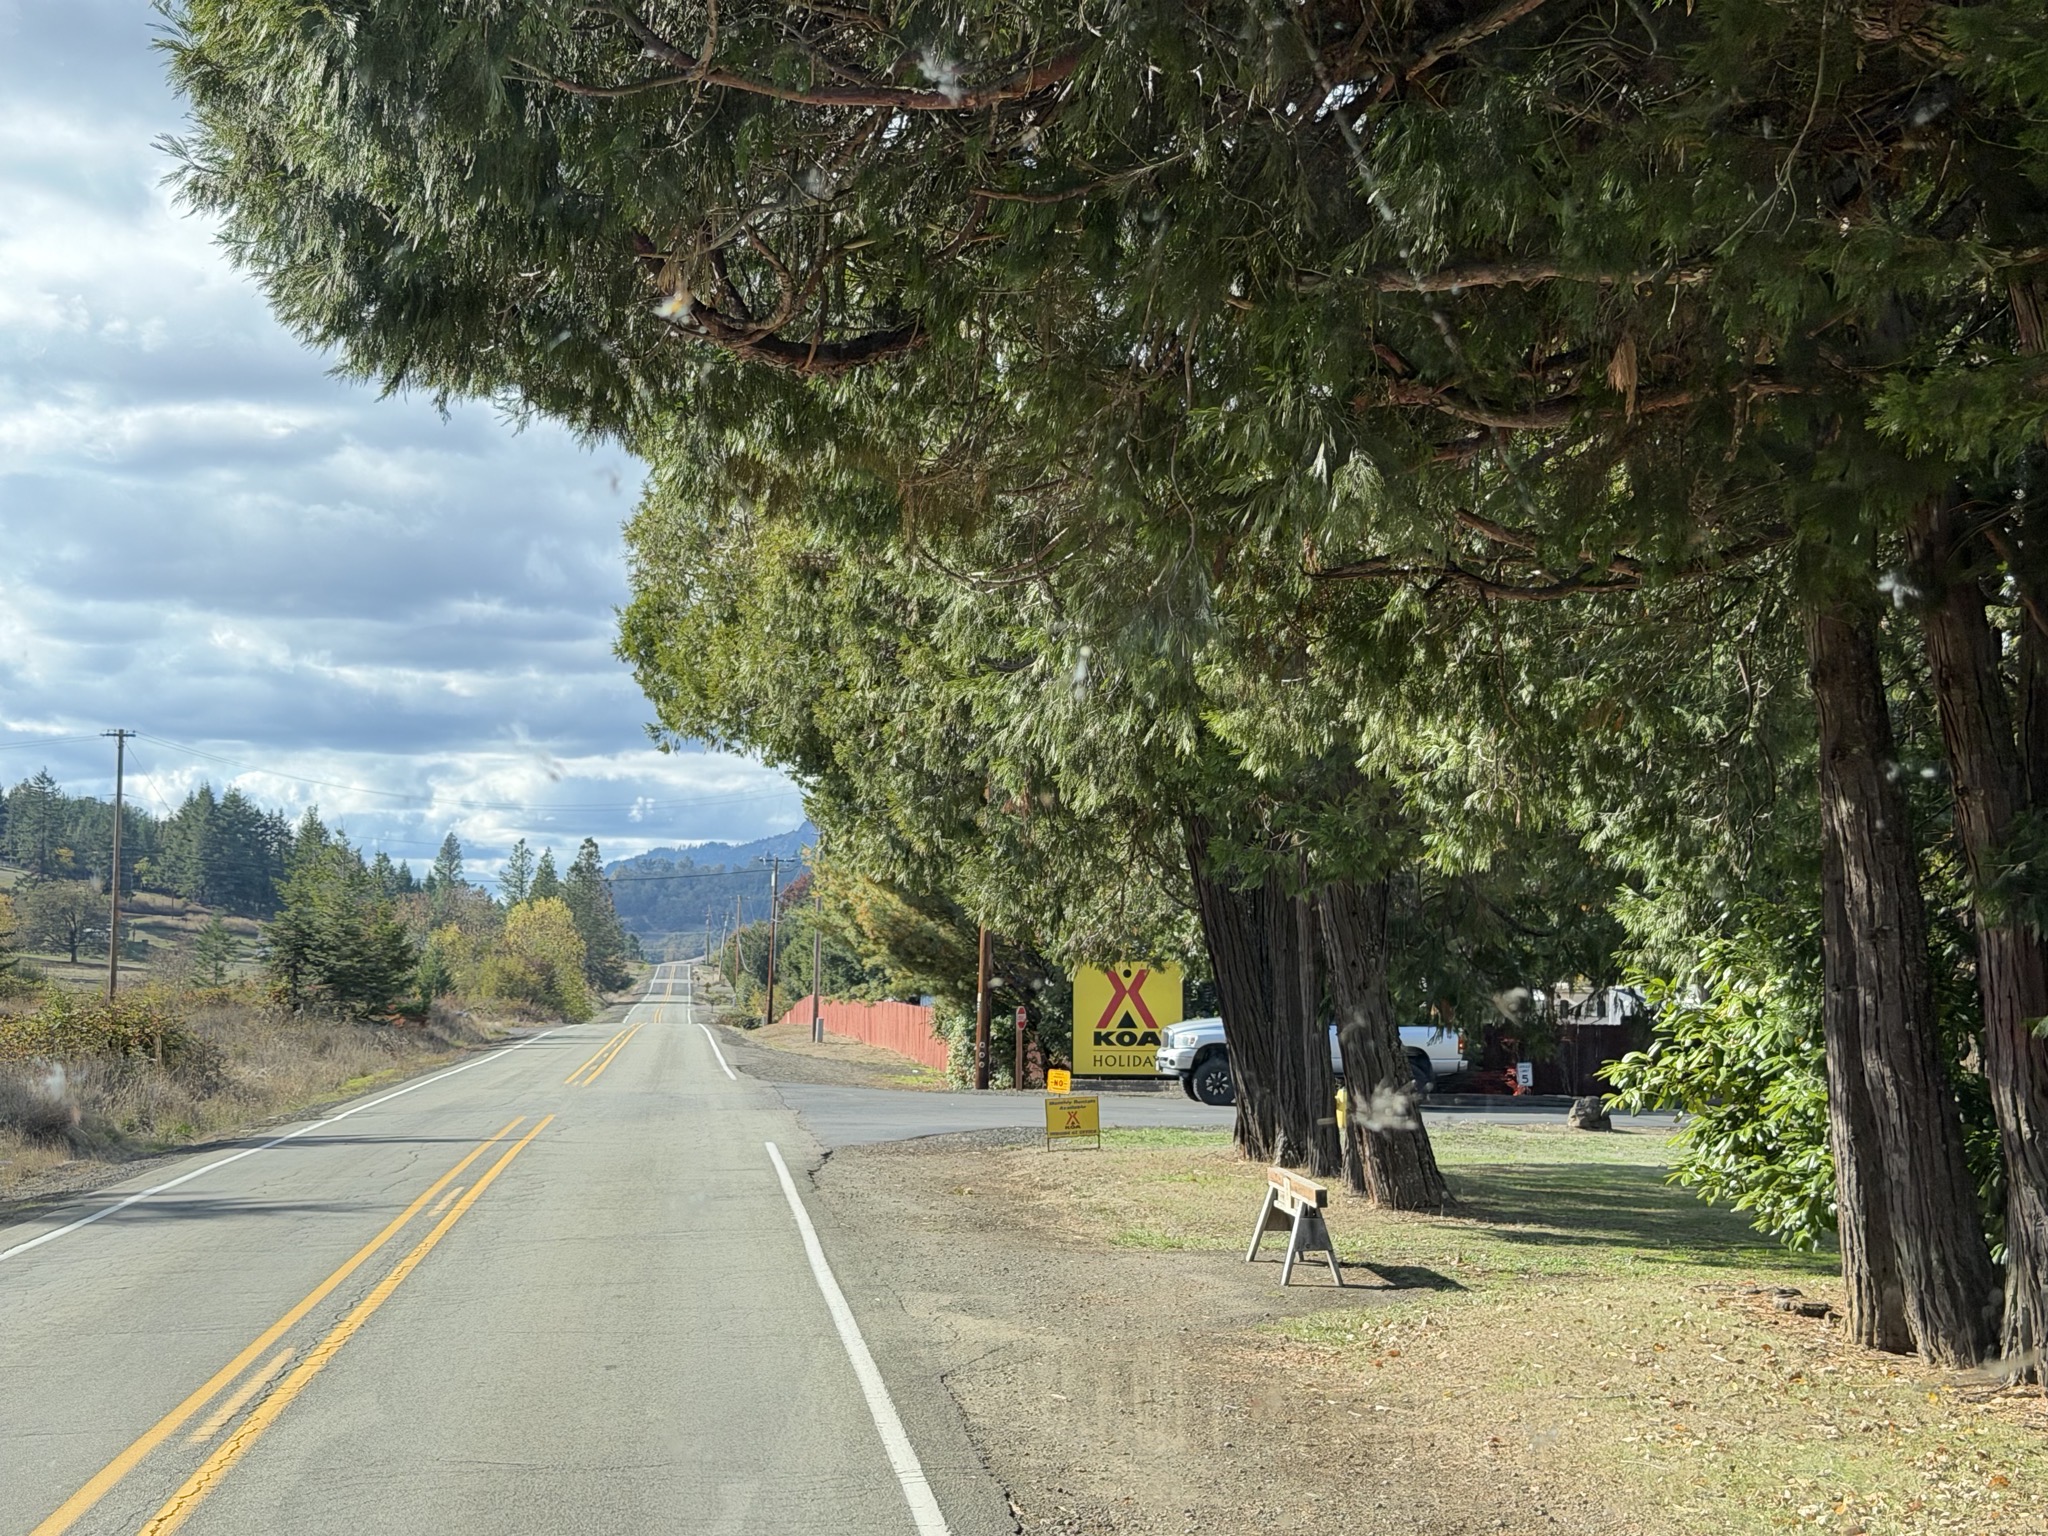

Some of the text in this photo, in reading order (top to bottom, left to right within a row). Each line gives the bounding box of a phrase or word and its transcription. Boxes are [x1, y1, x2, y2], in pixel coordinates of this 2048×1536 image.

[1093, 1031, 1161, 1047] KOA
[1053, 1079, 1064, 1087] NO
[1522, 1074, 1529, 1084] 5
